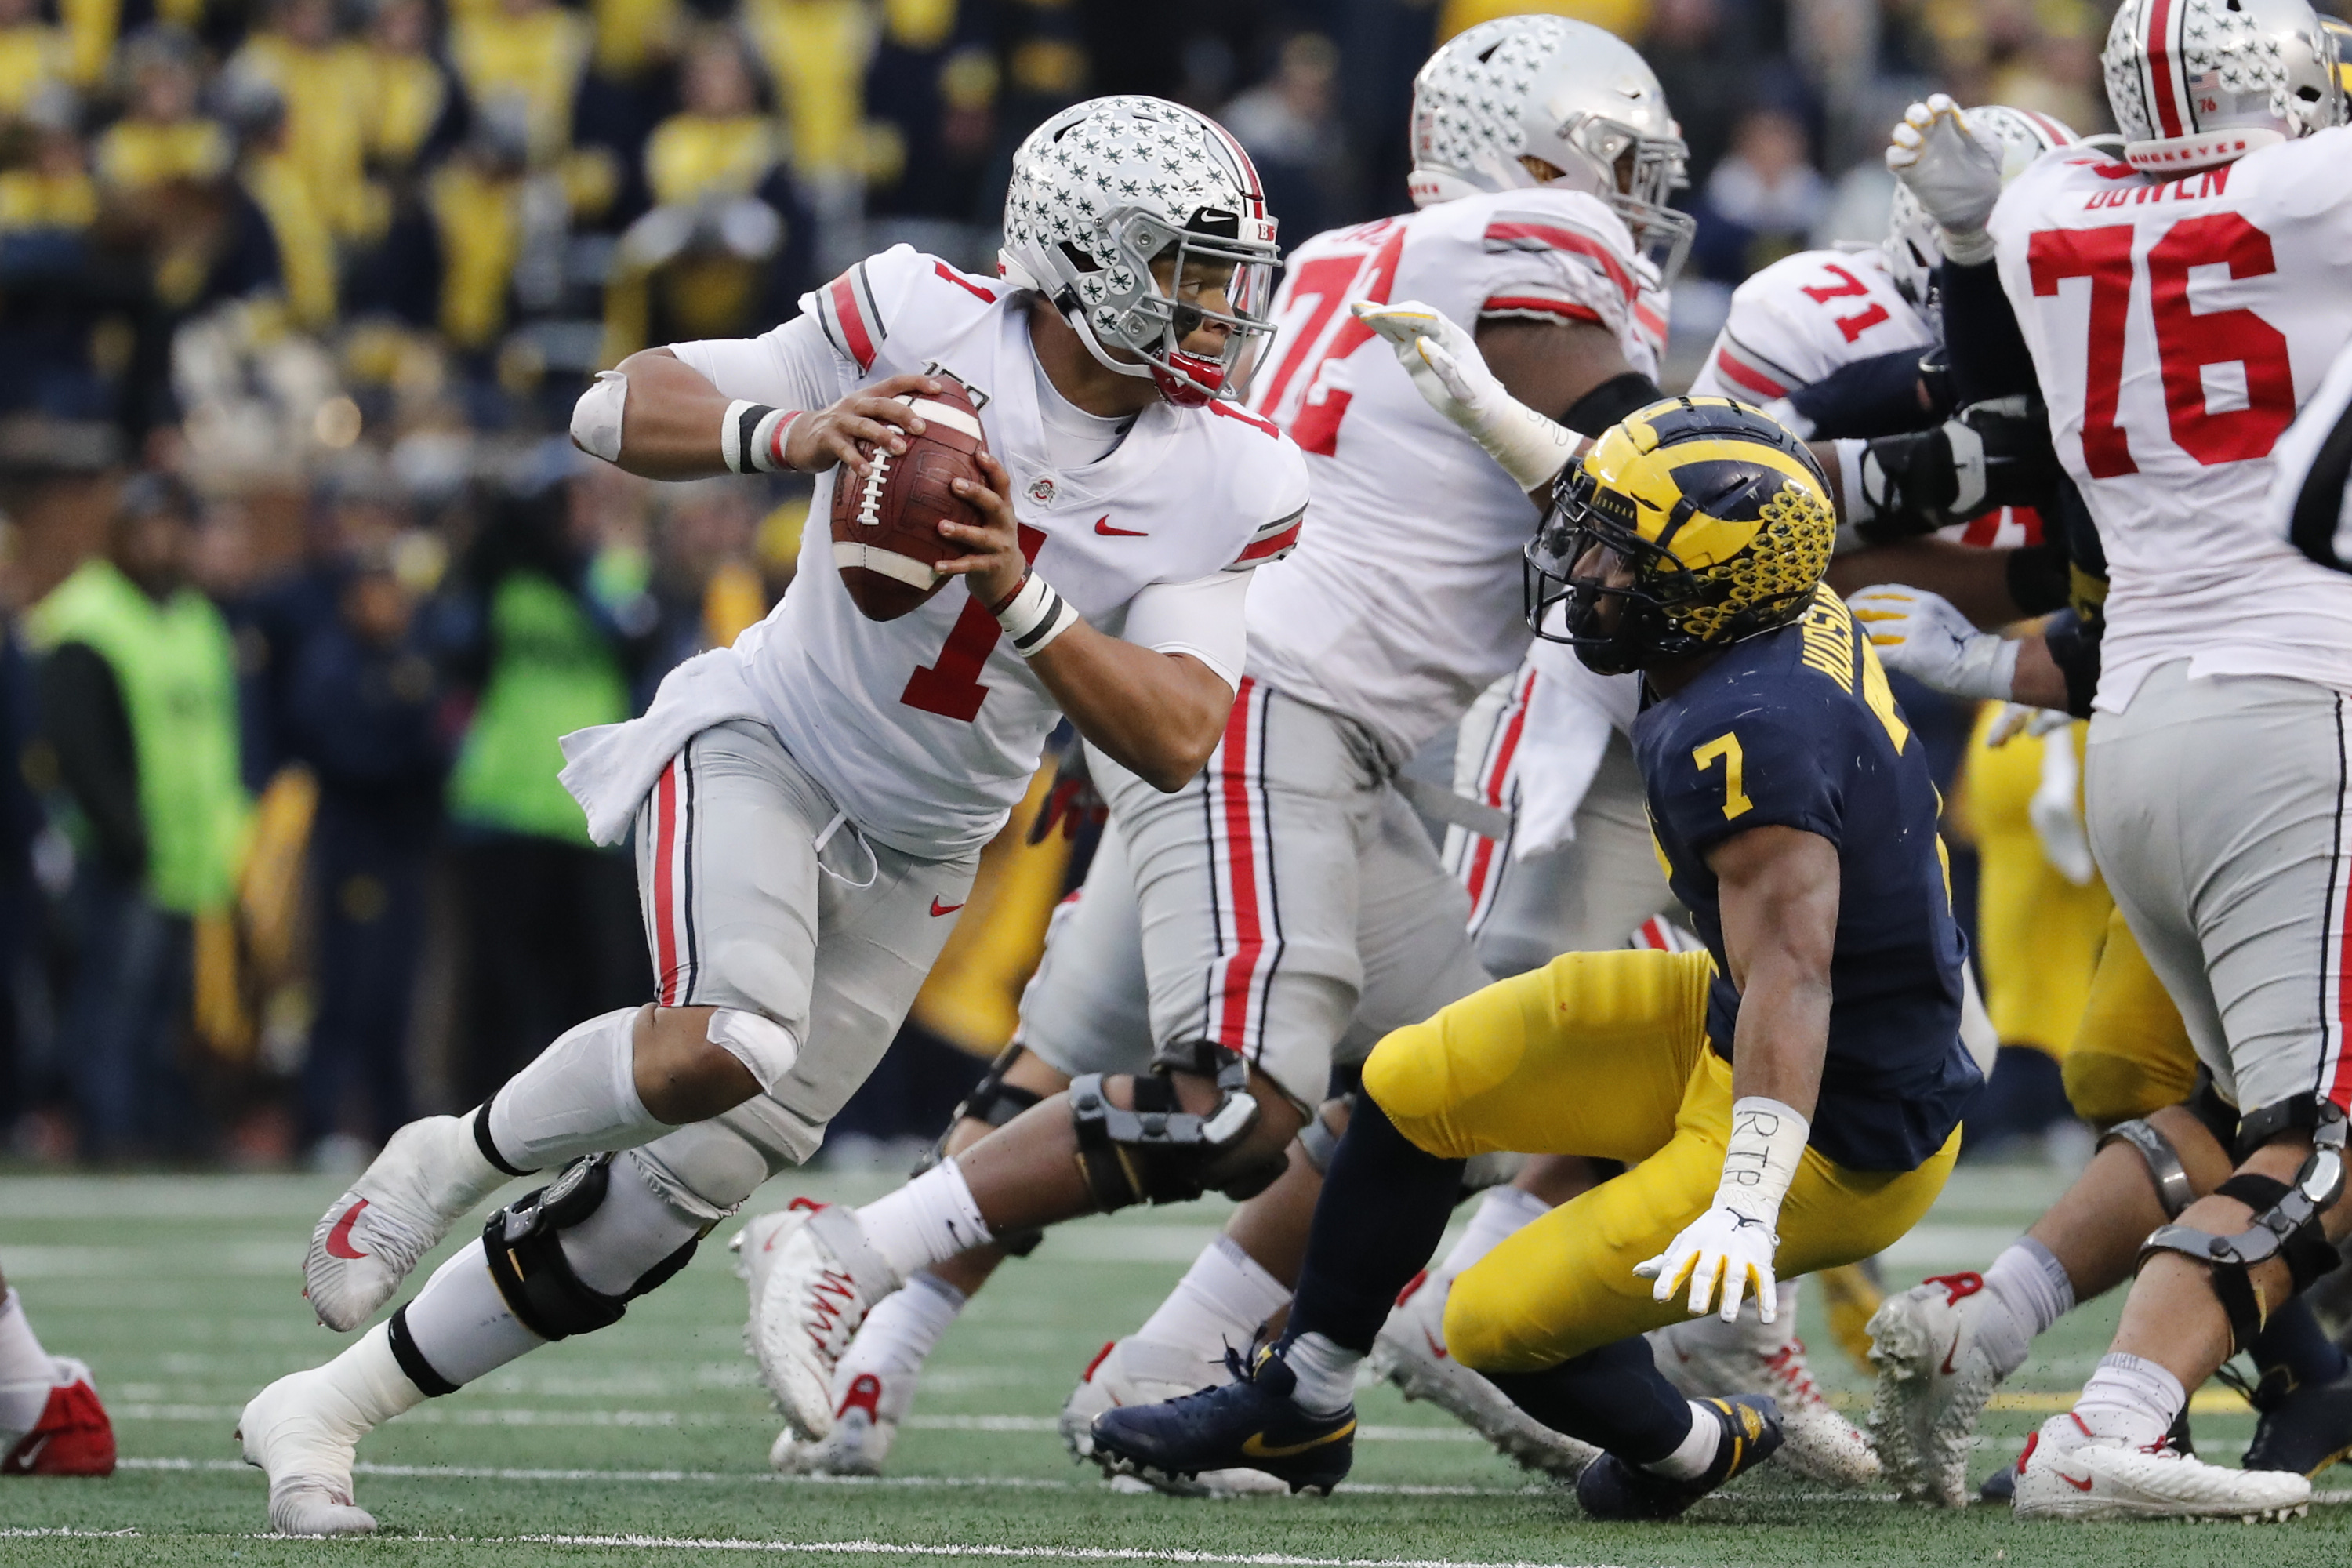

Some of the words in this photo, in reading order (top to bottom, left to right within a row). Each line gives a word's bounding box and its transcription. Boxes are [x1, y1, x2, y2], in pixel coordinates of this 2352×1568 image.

[1800, 263, 1890, 343] 71
[2027, 210, 2296, 480] 76
[1691, 731, 1754, 821] 7
